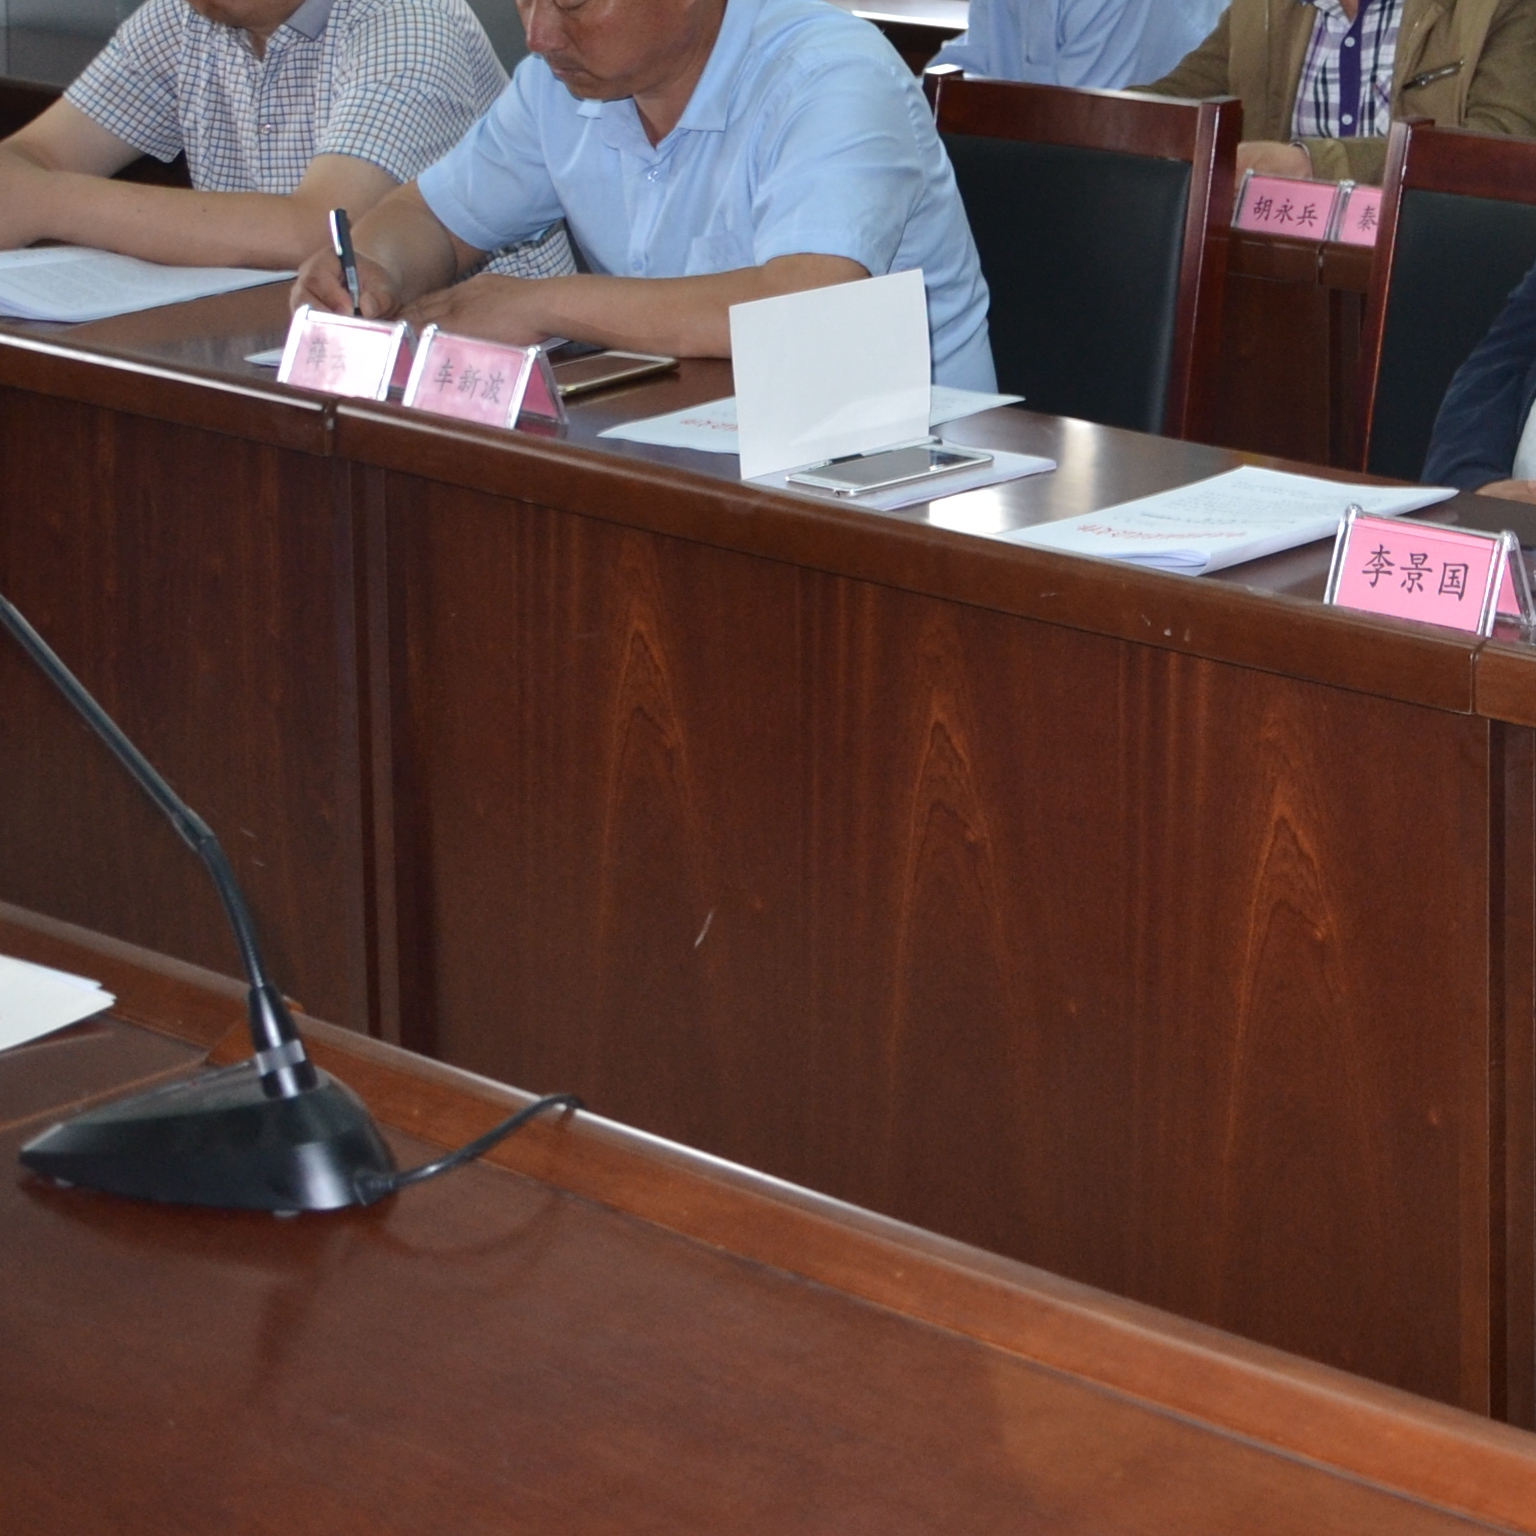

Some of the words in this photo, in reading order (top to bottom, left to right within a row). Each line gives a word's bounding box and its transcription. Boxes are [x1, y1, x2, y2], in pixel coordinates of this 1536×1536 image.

[1253, 196, 1318, 227] 胡永兵
[1361, 544, 1469, 601] 李景国
